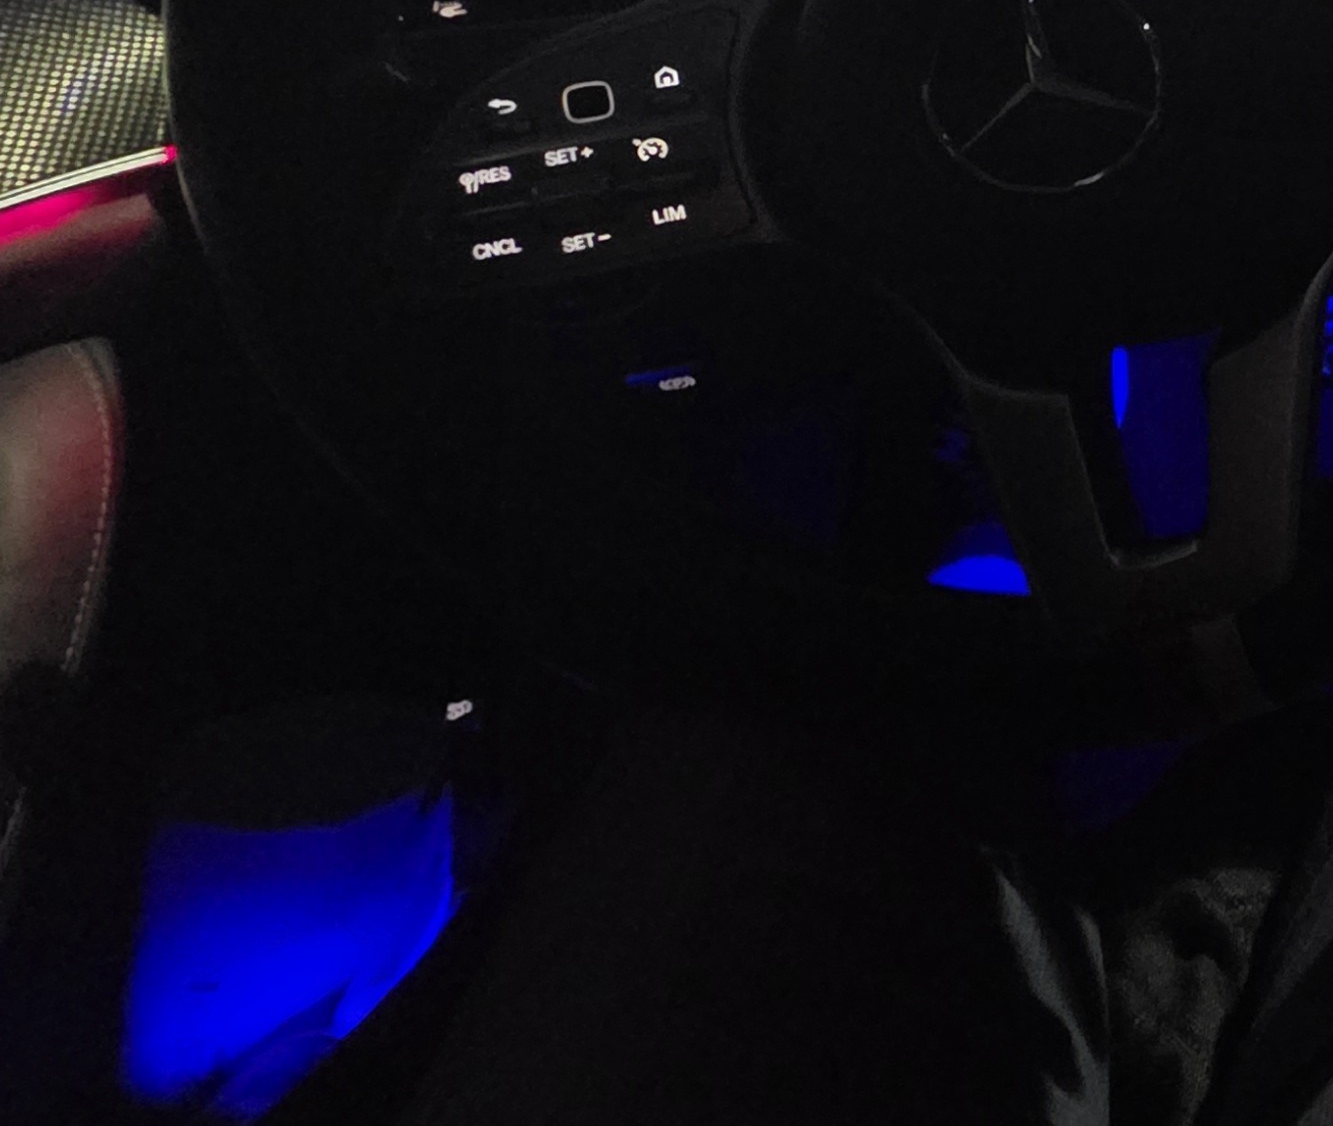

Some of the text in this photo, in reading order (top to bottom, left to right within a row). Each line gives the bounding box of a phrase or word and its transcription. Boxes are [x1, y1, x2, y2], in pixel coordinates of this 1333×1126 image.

[544, 145, 594, 167] SET+
[651, 204, 687, 225] LIM
[472, 238, 523, 260] CNCL
